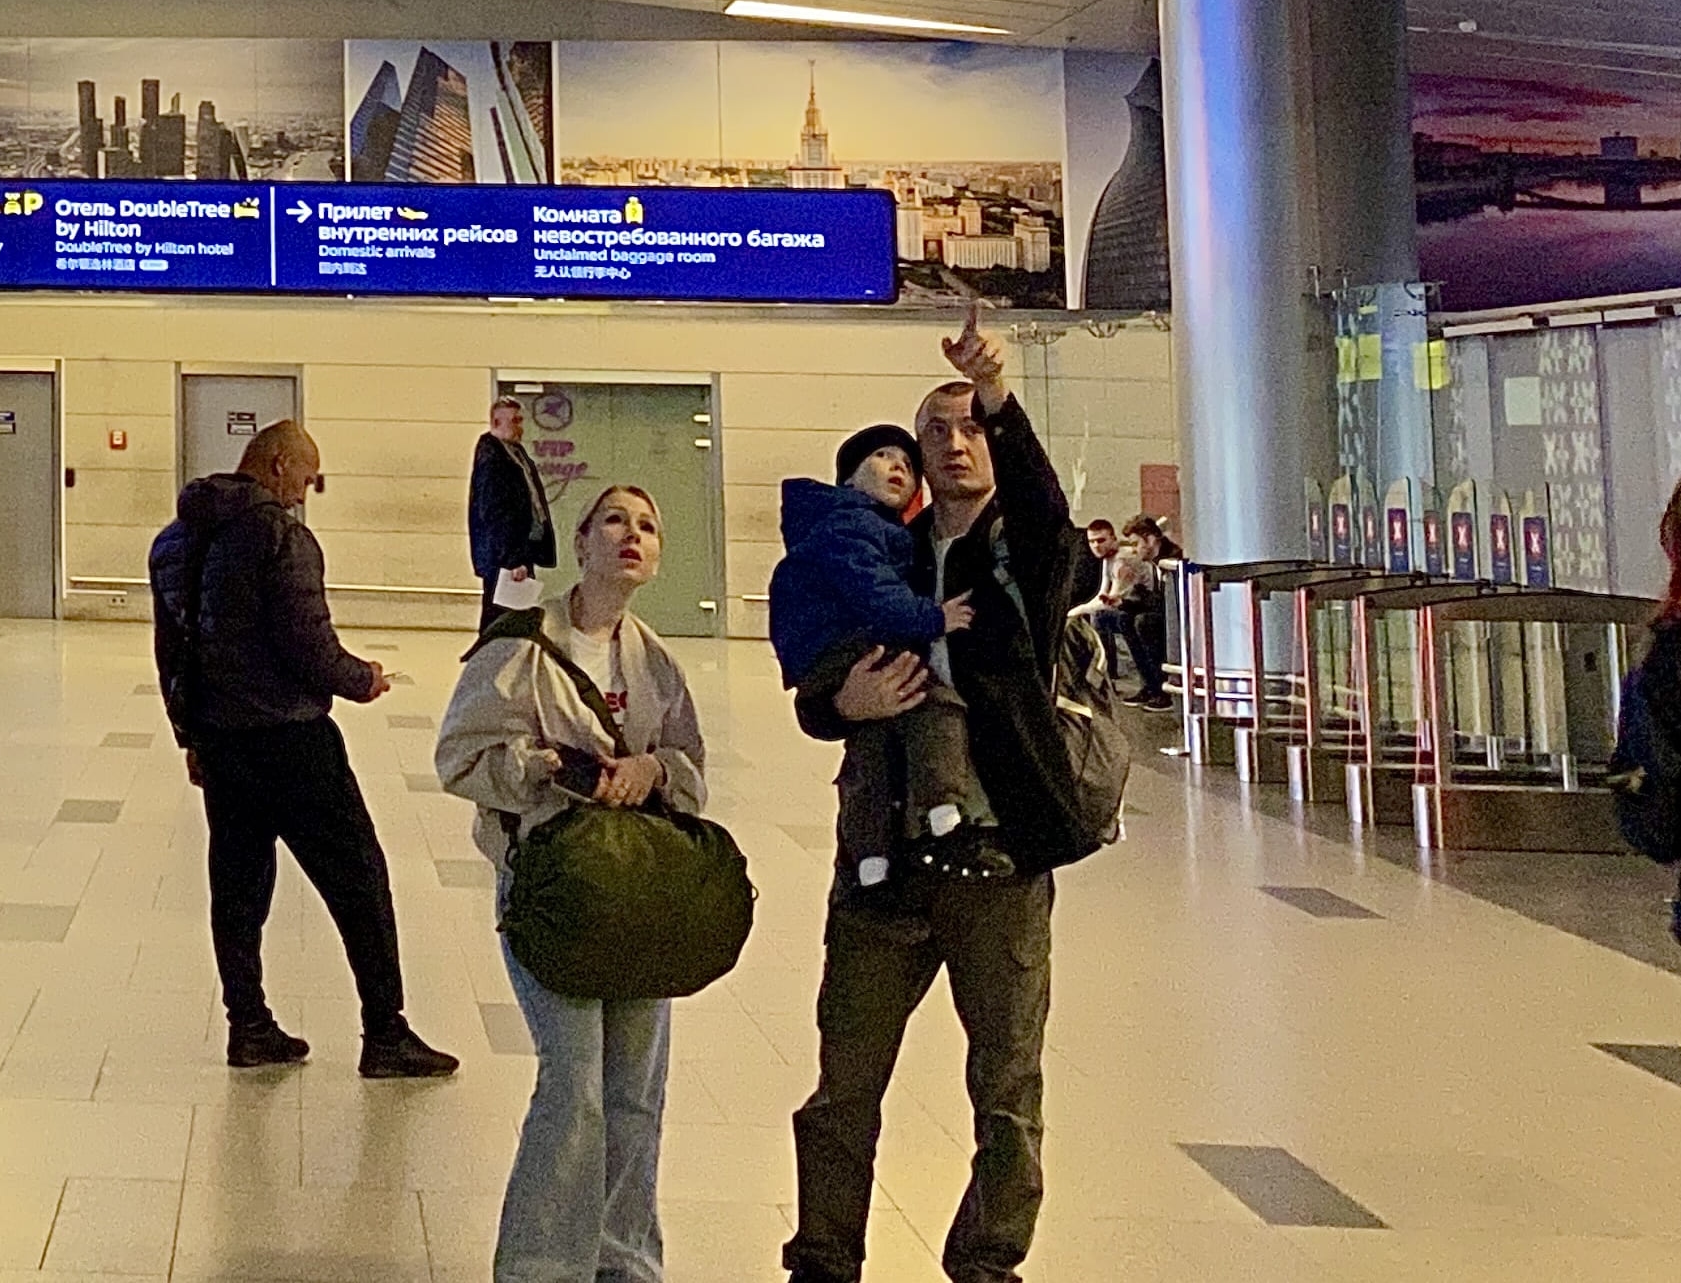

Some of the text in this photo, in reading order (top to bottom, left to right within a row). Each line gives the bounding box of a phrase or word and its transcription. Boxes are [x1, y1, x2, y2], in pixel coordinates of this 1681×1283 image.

[56, 199, 230, 218] Отель DoubleTree
[319, 203, 393, 222] Прилет
[534, 206, 621, 224] Комната
[56, 221, 141, 237] by Hilton
[319, 225, 517, 245] внутренних рейсов
[534, 229, 824, 248] невостребованного багажа
[56, 241, 233, 255] DoubleTree by Hilton hotel
[319, 245, 435, 259] Domestic arrivals
[534, 250, 716, 265] Unclaimed baggage room
